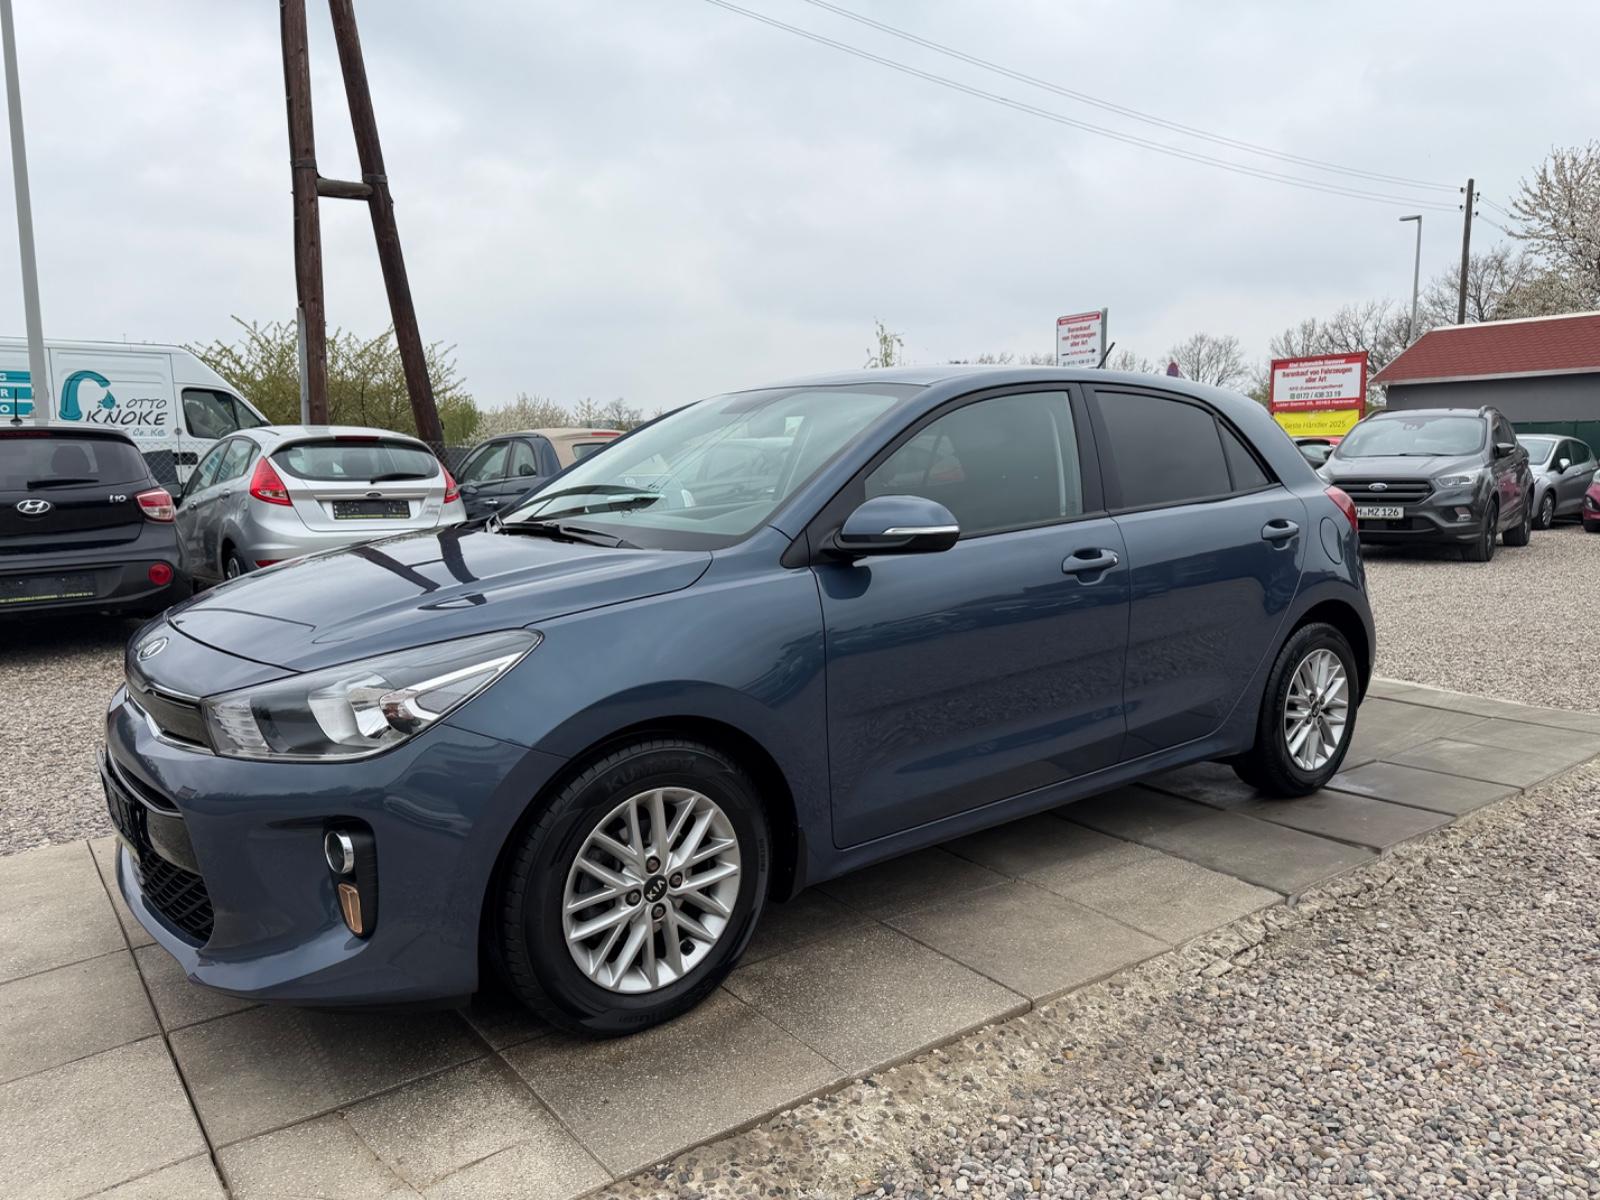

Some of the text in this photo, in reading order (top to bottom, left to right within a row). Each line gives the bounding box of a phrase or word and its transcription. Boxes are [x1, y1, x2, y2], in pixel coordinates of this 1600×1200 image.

[126, 398, 167, 409] OTTO
[86, 408, 168, 426] KNOKE
[646, 880, 665, 900] KIA
